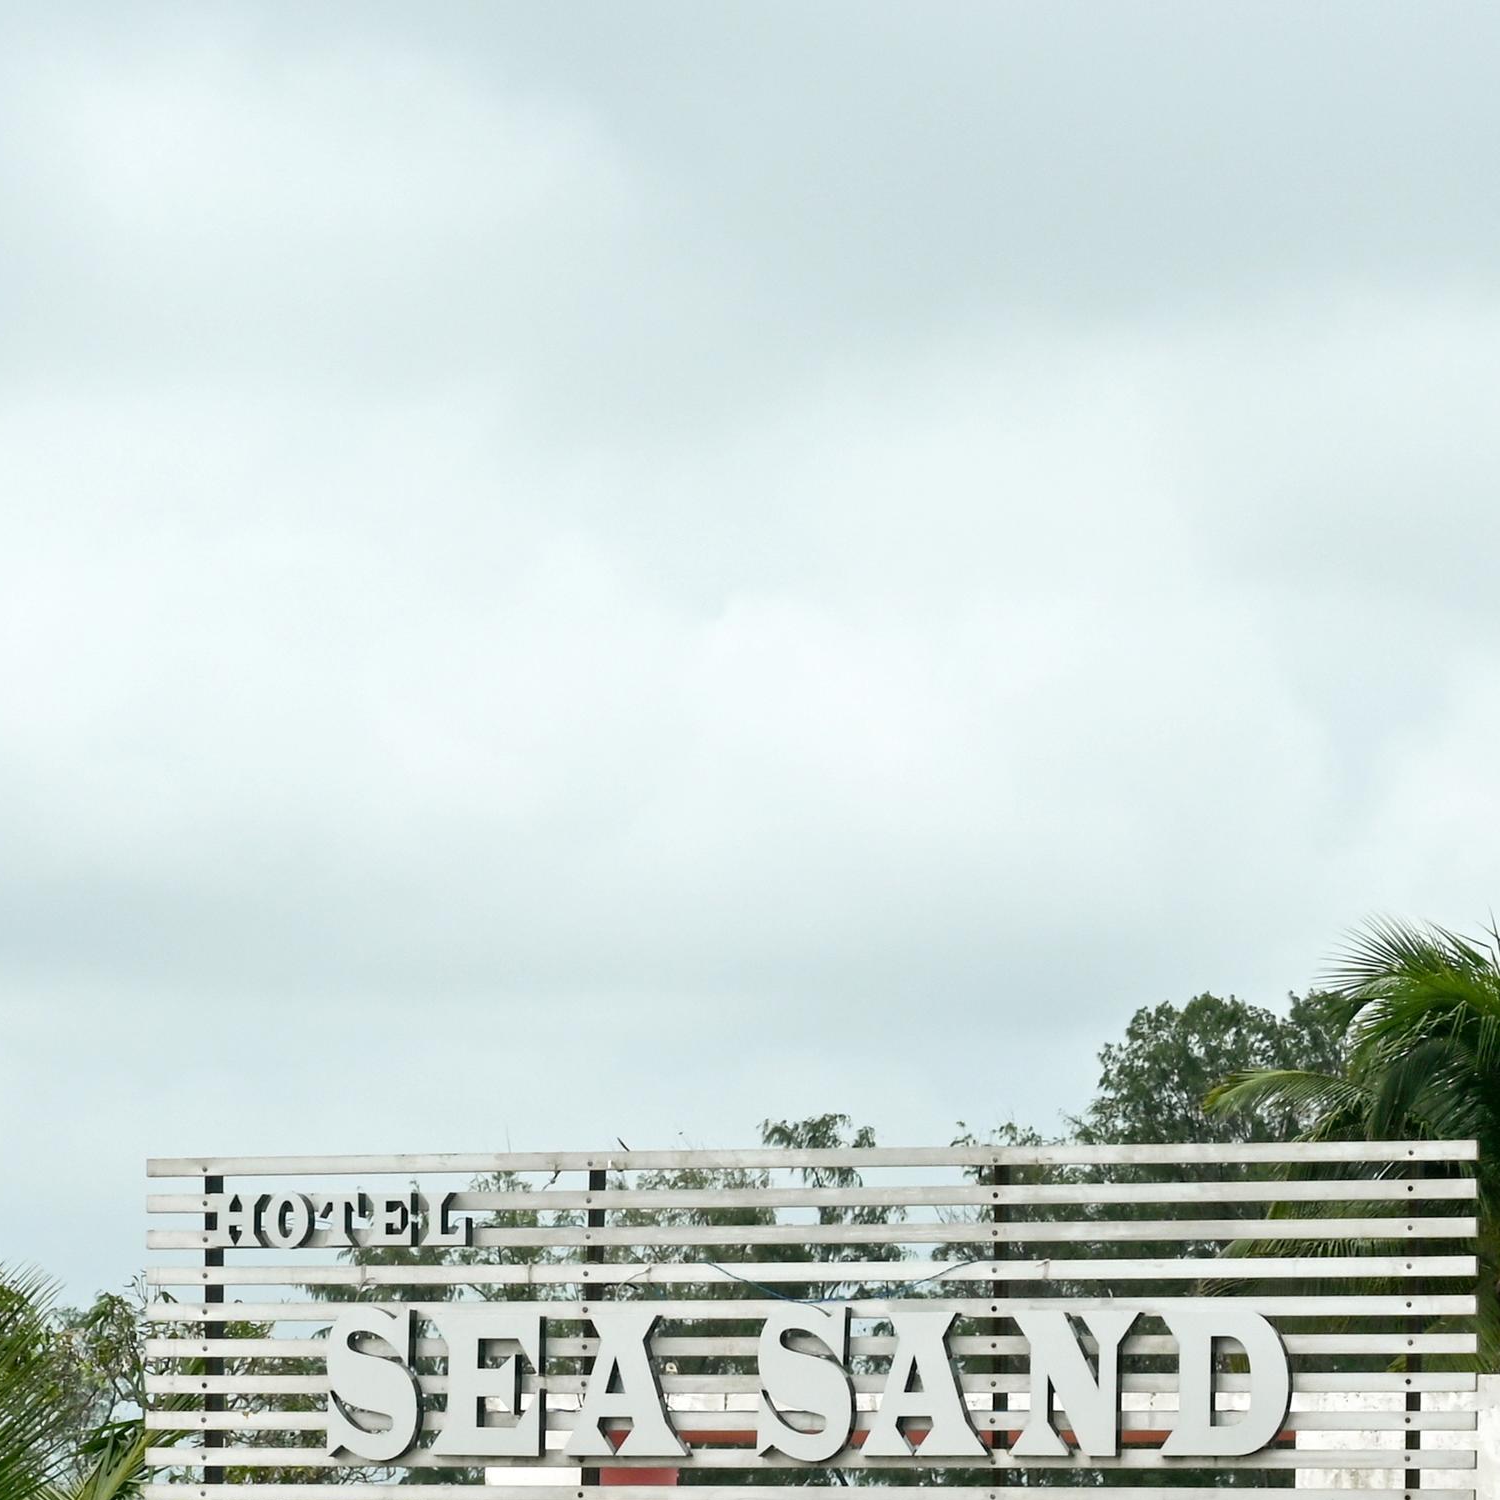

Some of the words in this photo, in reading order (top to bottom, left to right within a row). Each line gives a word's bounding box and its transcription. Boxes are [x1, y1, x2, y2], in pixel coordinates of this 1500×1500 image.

[210, 1191, 473, 1248] HOTEL
[326, 1306, 692, 1462] SEA
[757, 1303, 1293, 1462] SAND
